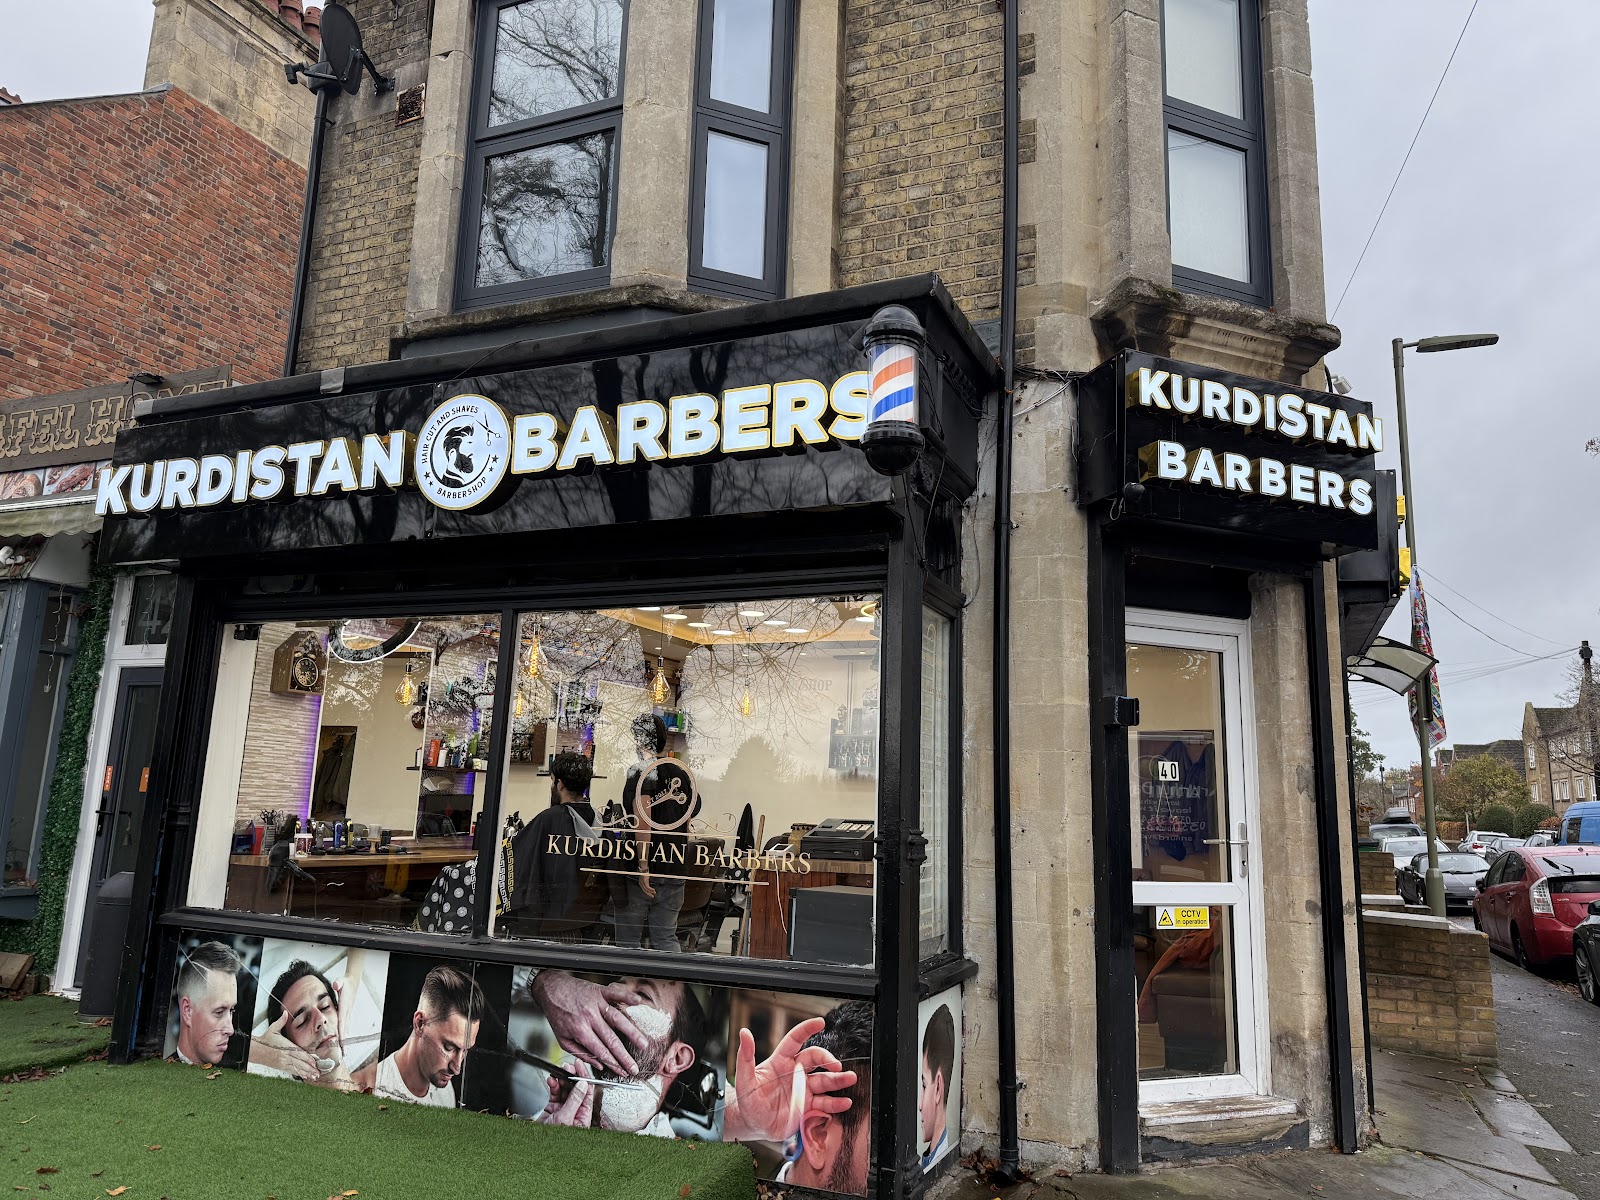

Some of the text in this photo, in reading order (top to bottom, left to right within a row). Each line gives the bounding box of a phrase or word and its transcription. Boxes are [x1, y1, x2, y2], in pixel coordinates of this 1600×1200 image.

[0, 403, 81, 458] FEL
[1138, 367, 1383, 452] KURDISTAN
[94, 370, 873, 516] KURDISTAN BARBERS
[421, 405, 479, 464] HAIR CUT AND SHAVES
[436, 476, 487, 499] BARBERSHOP
[1158, 440, 1374, 516] BARBERS
[1160, 762, 1177, 780] 40
[546, 834, 811, 875] KURDISTAN BARBERS
[1181, 909, 1201, 918] CCTV
[1182, 918, 1208, 926] operation
